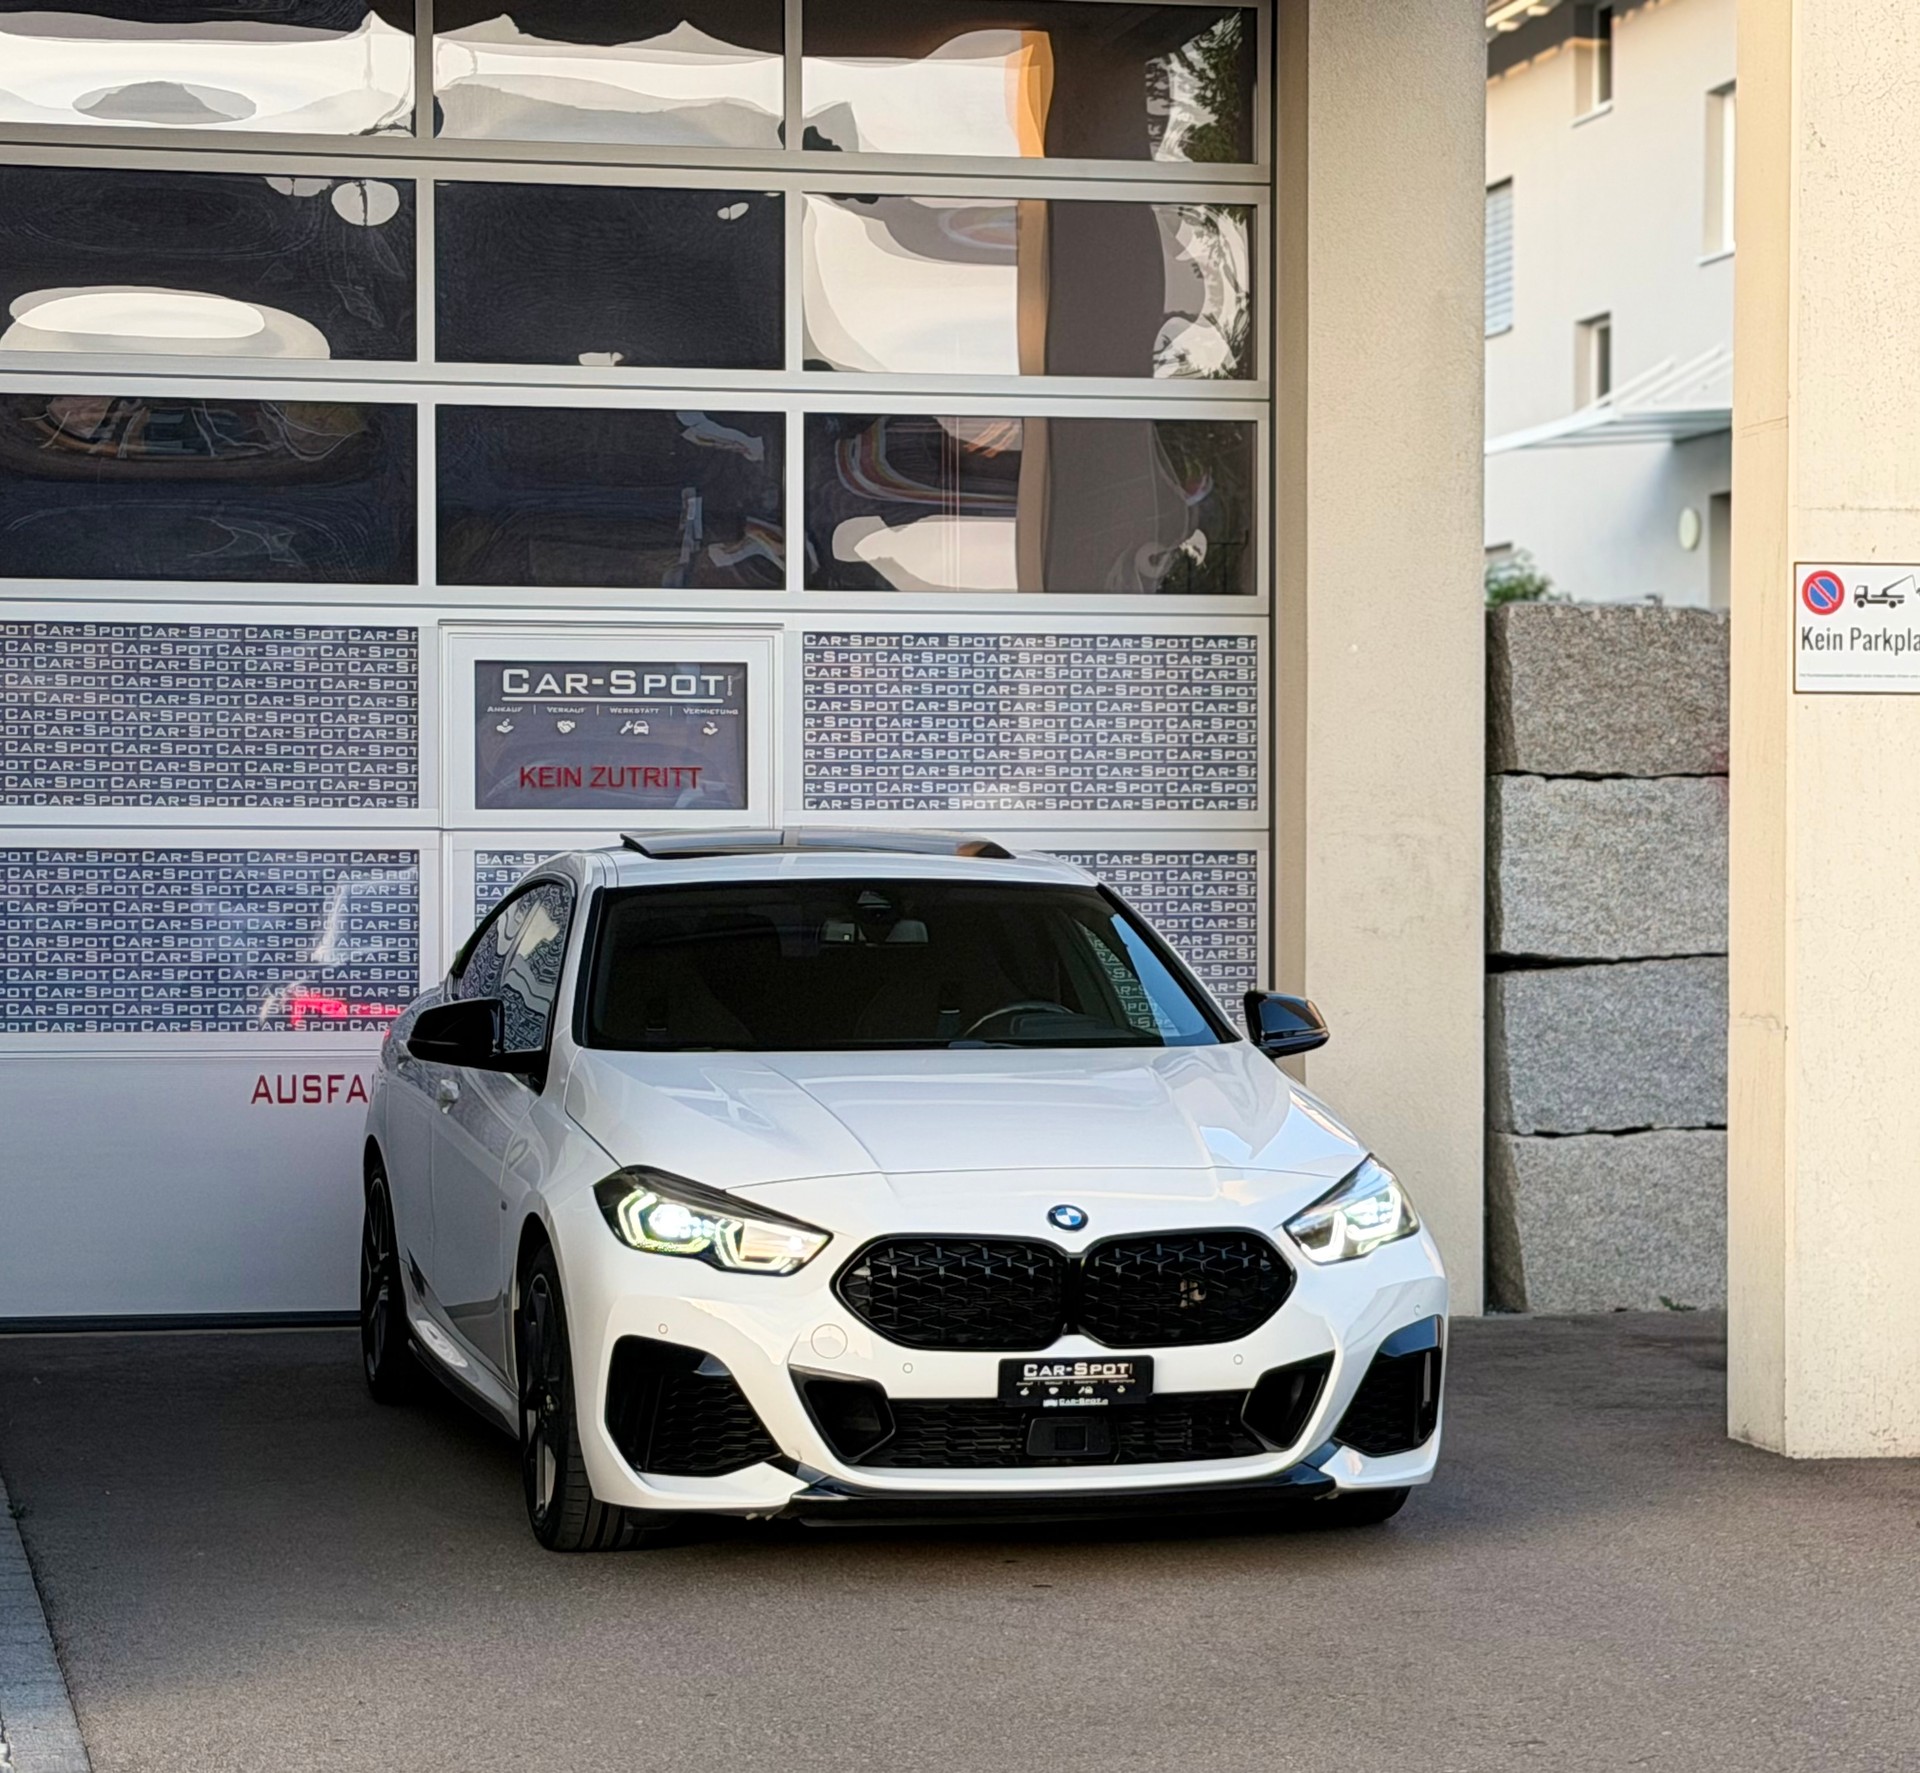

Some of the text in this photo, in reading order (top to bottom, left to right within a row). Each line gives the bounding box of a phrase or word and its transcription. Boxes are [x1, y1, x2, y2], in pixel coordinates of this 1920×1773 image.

[1801, 626, 1843, 651] Kein
[503, 669, 724, 696] CAR-SPOT
[519, 766, 703, 789] KEIN ZUTRITT
[251, 1074, 374, 1104] AUSFA
